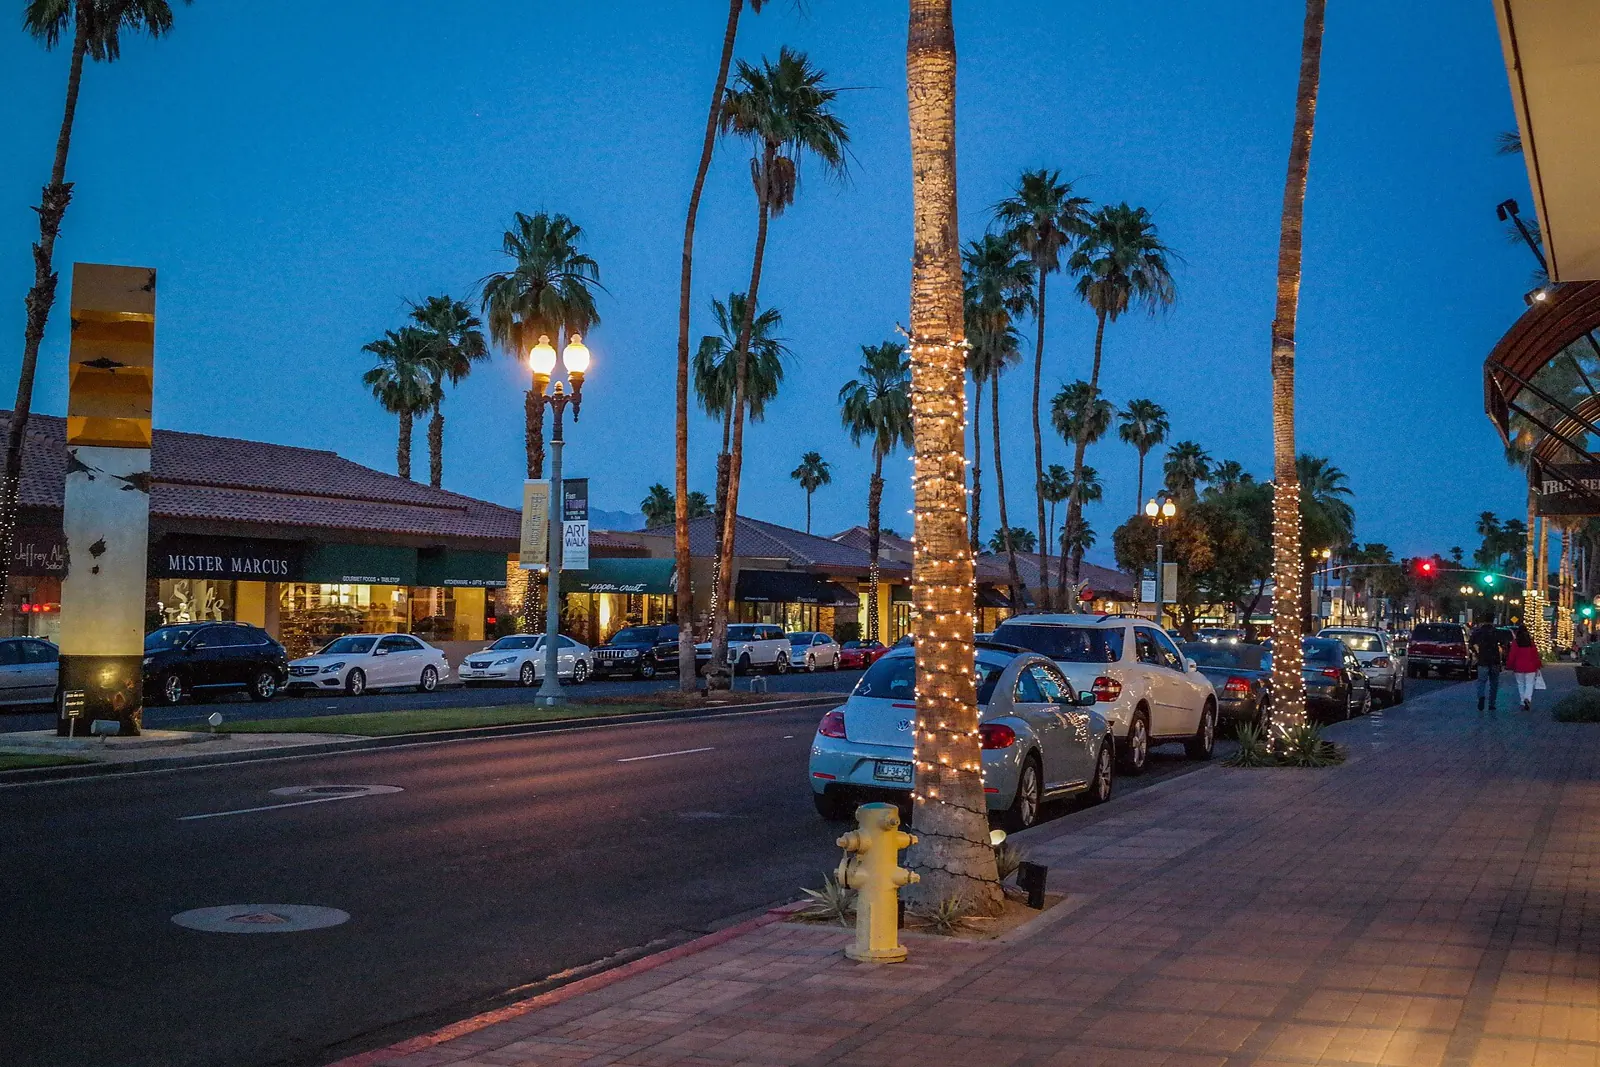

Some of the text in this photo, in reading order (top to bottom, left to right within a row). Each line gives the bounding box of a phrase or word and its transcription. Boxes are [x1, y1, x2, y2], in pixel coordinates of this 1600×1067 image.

[565, 524, 586, 537] ART
[565, 537, 587, 547] WALK
[14, 542, 48, 567] Jeffrey
[168, 554, 288, 575] MISTER MARCUS
[588, 583, 618, 593] upper
[619, 583, 648, 592] crust
